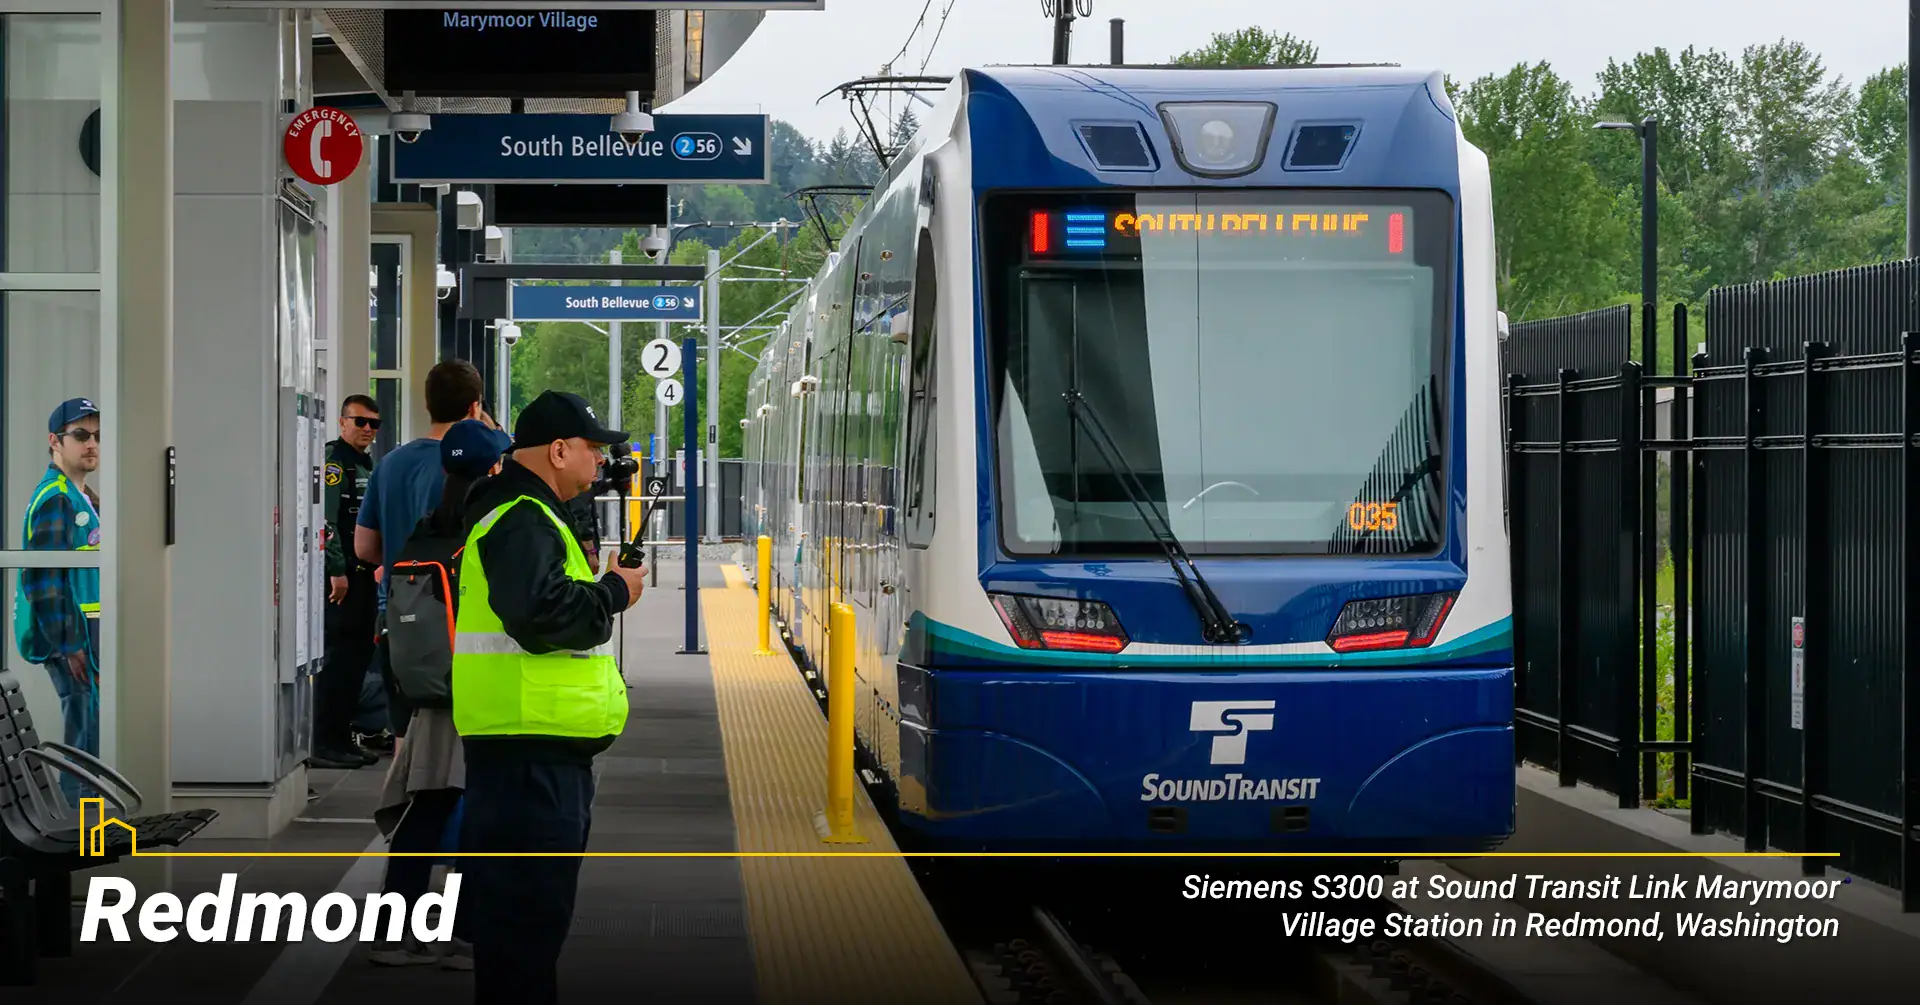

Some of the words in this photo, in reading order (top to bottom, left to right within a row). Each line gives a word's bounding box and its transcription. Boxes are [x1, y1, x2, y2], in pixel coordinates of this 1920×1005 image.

[443, 11, 535, 32] Marymoor
[539, 11, 598, 32] Village
[289, 109, 359, 138] EMERGENCY
[501, 135, 563, 157] South
[572, 135, 664, 157] Bellevue
[680, 139, 690, 154] 2
[697, 139, 716, 154] 56
[566, 296, 599, 309] South
[601, 296, 650, 309] Bellevue
[665, 298, 676, 308] 56
[653, 343, 670, 372] 2
[664, 384, 675, 401] 4
[1349, 502, 1397, 531] 035
